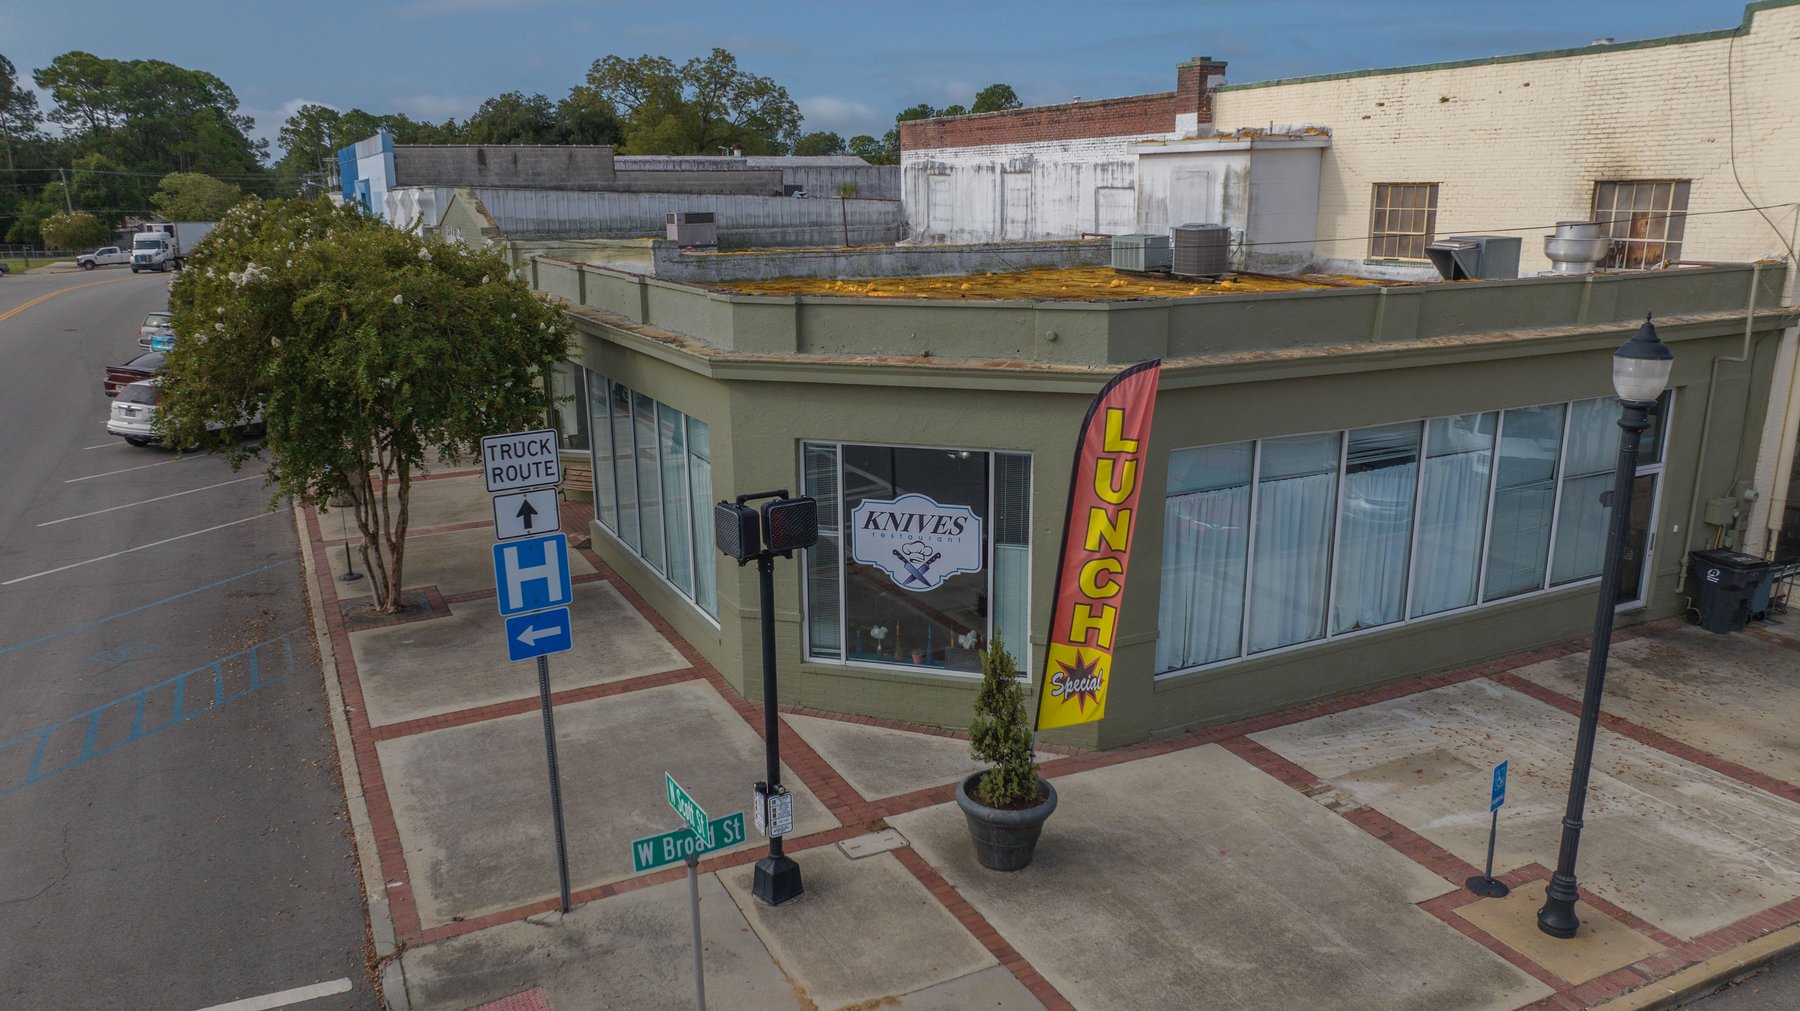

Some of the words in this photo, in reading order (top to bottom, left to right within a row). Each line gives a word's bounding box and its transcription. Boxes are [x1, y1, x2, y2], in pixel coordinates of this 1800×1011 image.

[487, 438, 552, 462] TRUCK
[492, 460, 556, 484] ROUTE
[861, 510, 968, 536] KNIVES
[872, 532, 961, 543] restaurant
[1068, 407, 1139, 650] LUNCH
[503, 539, 563, 610] H
[1051, 668, 1103, 700] Special
[696, 809, 706, 838] St
[637, 841, 654, 867] W
[723, 819, 741, 843] St
